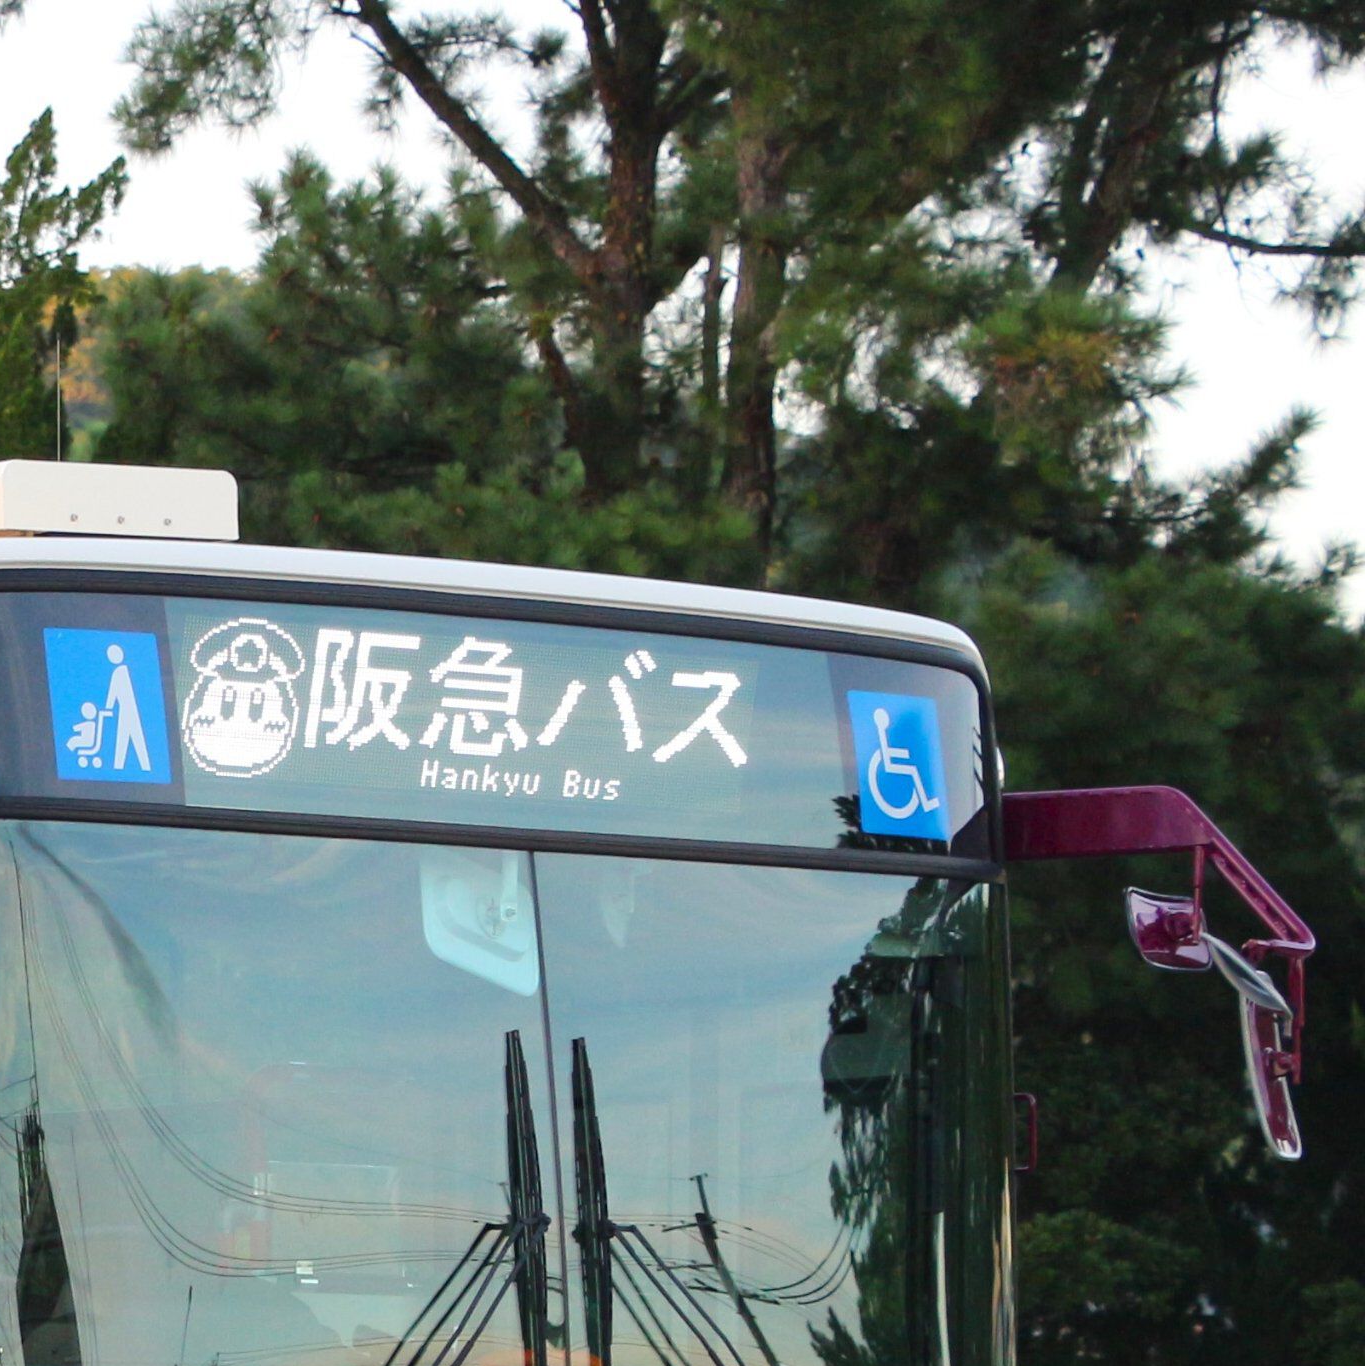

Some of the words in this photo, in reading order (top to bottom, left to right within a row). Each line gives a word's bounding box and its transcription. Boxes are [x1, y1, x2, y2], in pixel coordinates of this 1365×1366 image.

[304, 629, 748, 768] 阪急バス
[419, 759, 540, 797] Hankyu
[562, 770, 622, 801] Bus
